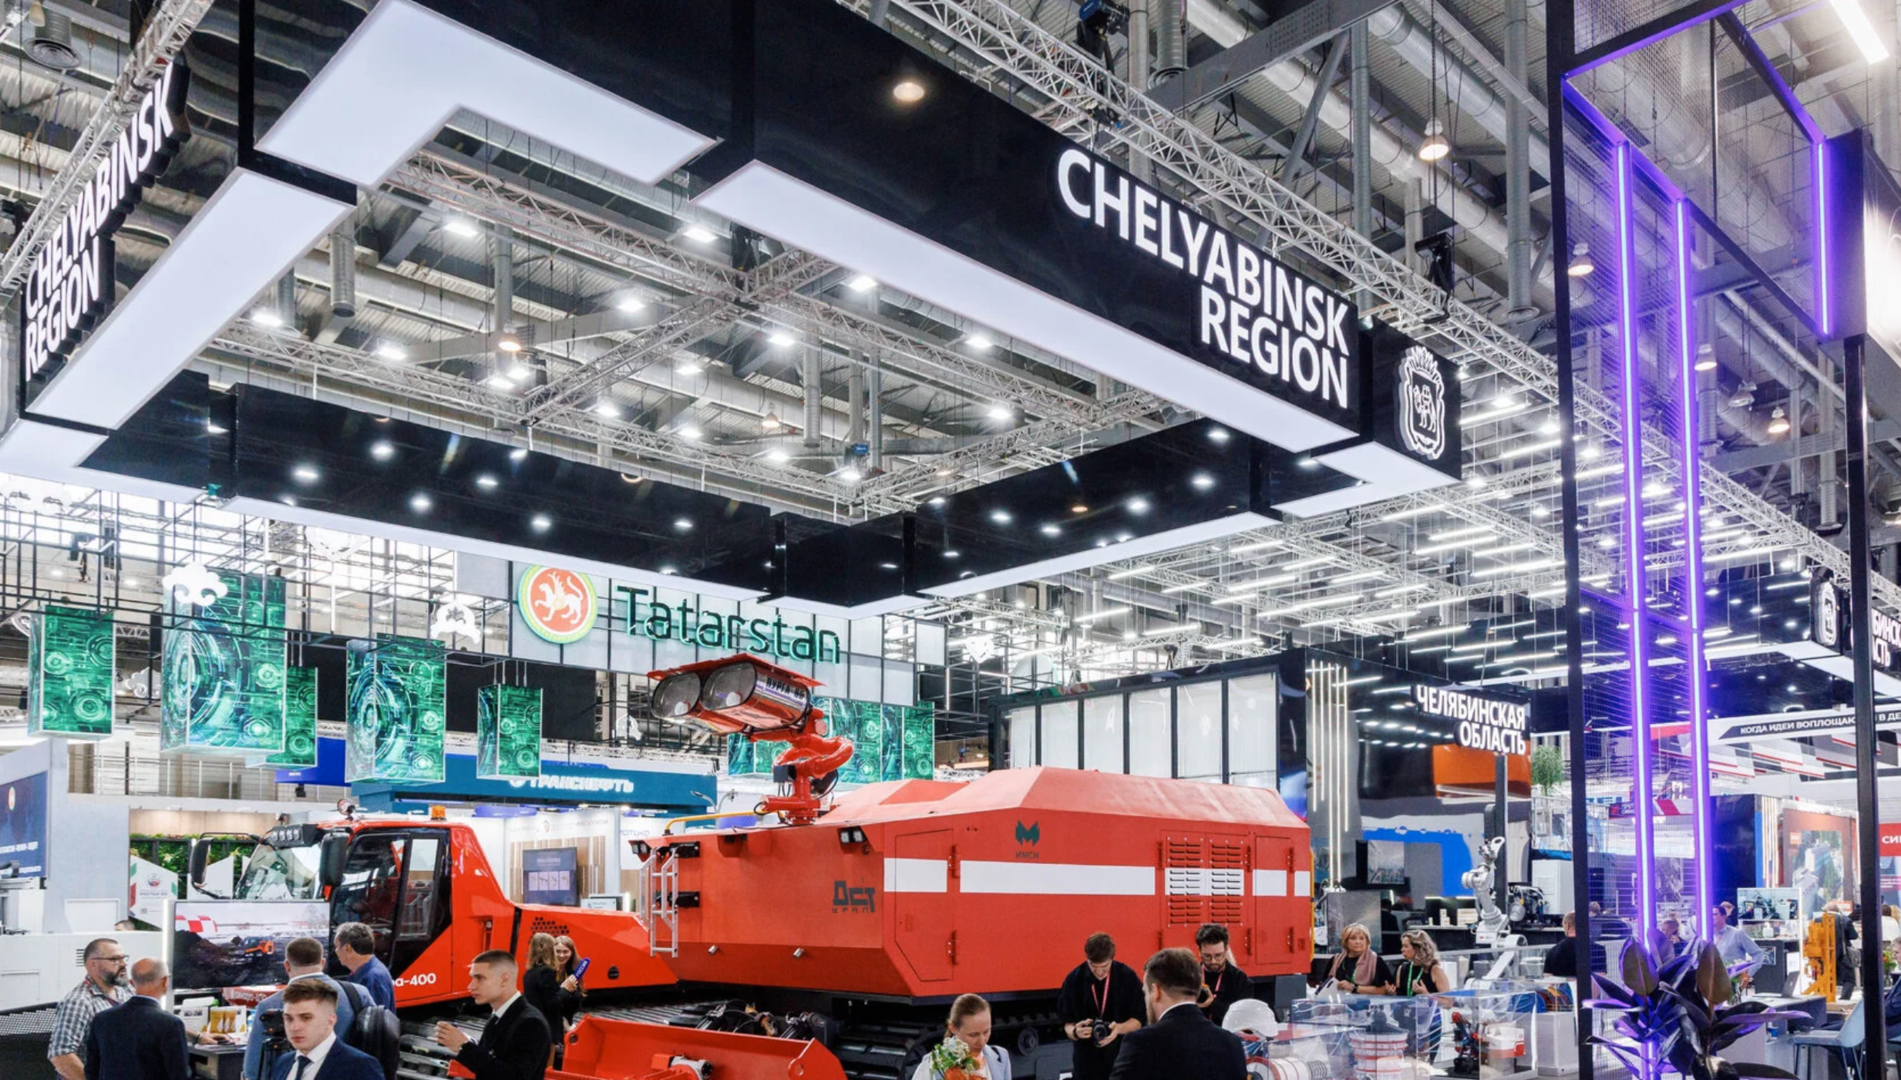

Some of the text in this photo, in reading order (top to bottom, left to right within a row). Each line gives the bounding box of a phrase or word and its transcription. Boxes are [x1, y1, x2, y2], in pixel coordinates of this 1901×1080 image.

[26, 61, 174, 319] CHELYABINSK
[1058, 149, 1350, 356] CHELYABINSK
[25, 235, 100, 382] REGION
[1201, 285, 1348, 409] REGION
[615, 585, 841, 664] Tatarstan
[1416, 684, 1526, 731] ЧЕЛЯБИНСКАЯ
[1460, 720, 1526, 756] ОБЛАСТЬ
[1740, 725, 1768, 734] КОГДА
[1769, 723, 1795, 732] ИДЕИ
[392, 972, 437, 987] а-400
